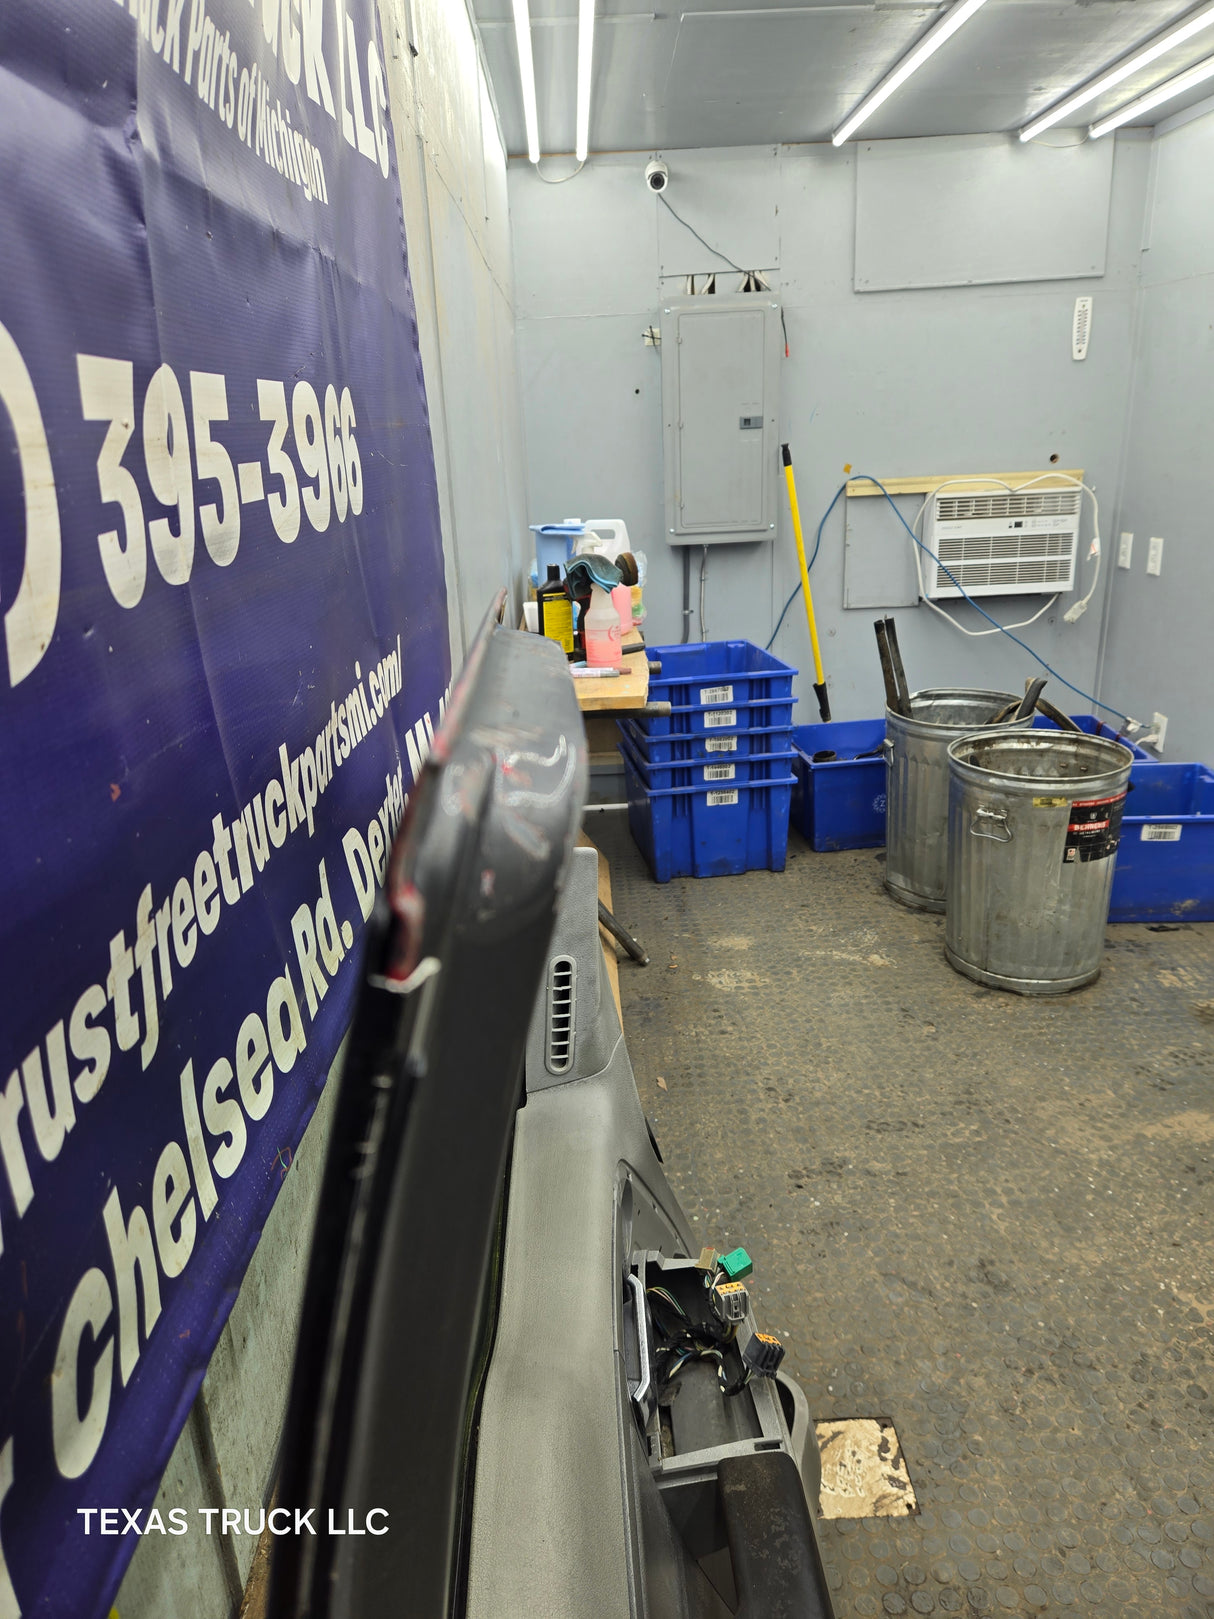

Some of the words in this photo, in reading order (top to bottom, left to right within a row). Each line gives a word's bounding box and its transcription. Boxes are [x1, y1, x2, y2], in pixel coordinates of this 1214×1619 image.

[184, 0, 238, 129] Parts
[238, 62, 257, 149] of
[255, 69, 329, 206] Michigan
[336, 0, 389, 179] LLC
[76, 352, 364, 609] 395-3966
[0, 633, 403, 1256] rustfreetruckpartsmi.com/
[51, 962, 307, 1479] Chelsea
[290, 857, 354, 1021] Rd.
